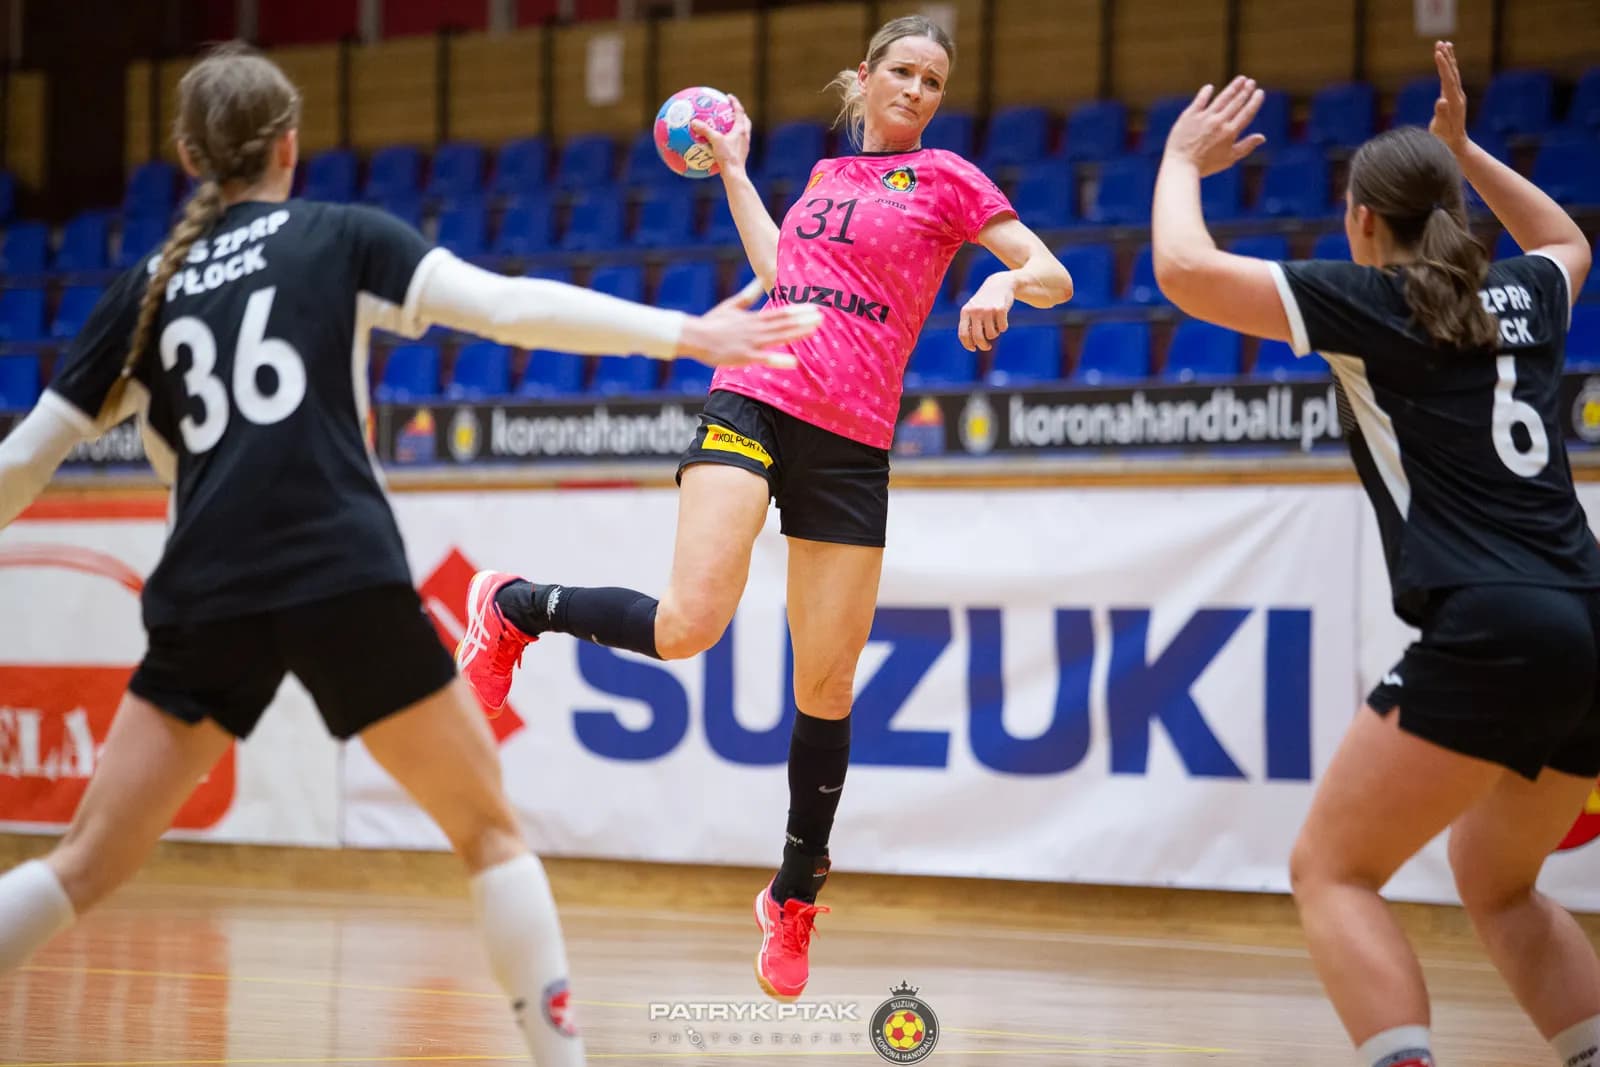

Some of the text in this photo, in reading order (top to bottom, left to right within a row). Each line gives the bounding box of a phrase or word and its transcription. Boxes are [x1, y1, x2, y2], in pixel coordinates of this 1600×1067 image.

[212, 209, 290, 260] ZPRP
[796, 198, 859, 245] 31
[166, 243, 267, 303] PŁOCK
[769, 285, 890, 324] SUZUKI
[159, 285, 307, 455] 36
[491, 403, 701, 455] koronahandb
[1008, 382, 1343, 453] koronahandball.pl
[1492, 355, 1550, 478] 6
[571, 606, 1313, 783] SUZUKI
